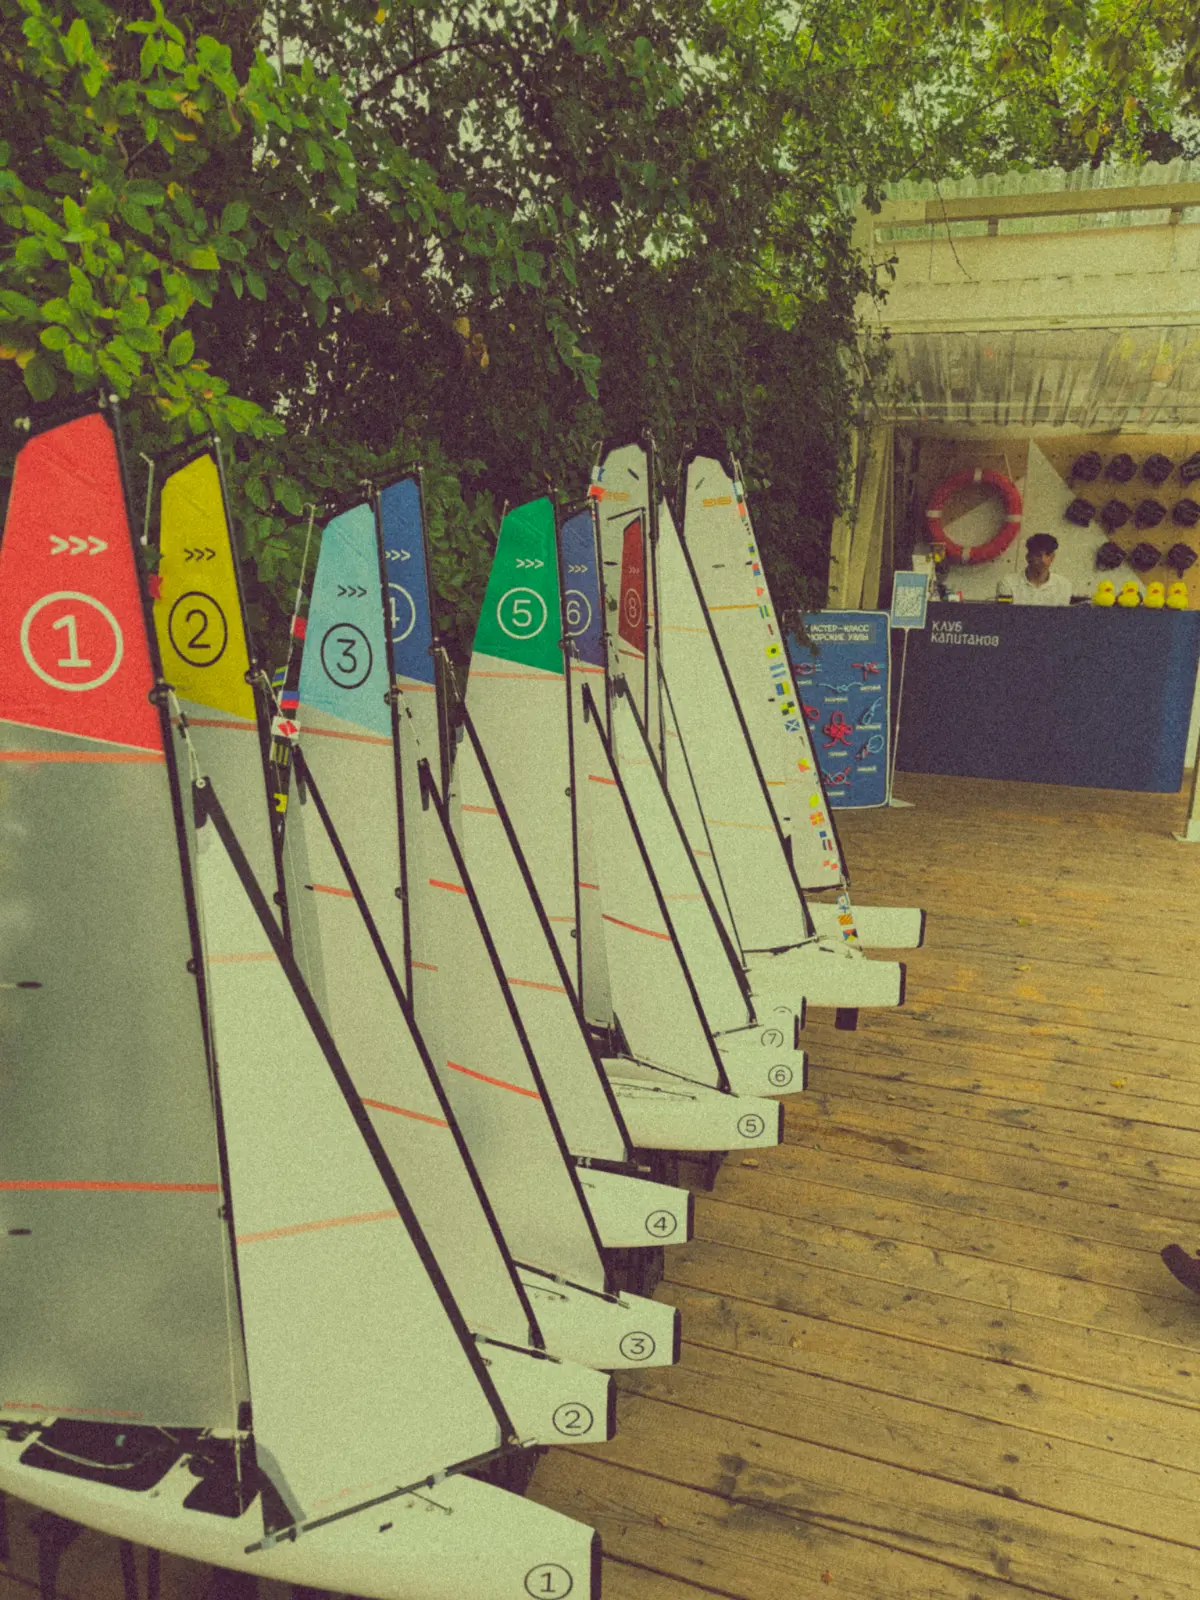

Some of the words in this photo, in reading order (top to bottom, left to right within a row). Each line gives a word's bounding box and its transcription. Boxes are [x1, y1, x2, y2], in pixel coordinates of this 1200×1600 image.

[511, 600, 533, 627] 5
[566, 600, 581, 625] 6
[628, 597, 637, 619] 8
[185, 609, 211, 648] 2
[52, 615, 92, 667] 1
[337, 638, 357, 674] 3
[767, 1032, 777, 1045] 7
[775, 1069, 786, 1082] 6
[745, 1119, 757, 1133] 5
[653, 1216, 668, 1231] 4
[630, 1338, 645, 1355] 3
[564, 1410, 581, 1429] 2
[540, 1572, 556, 1593] 1
